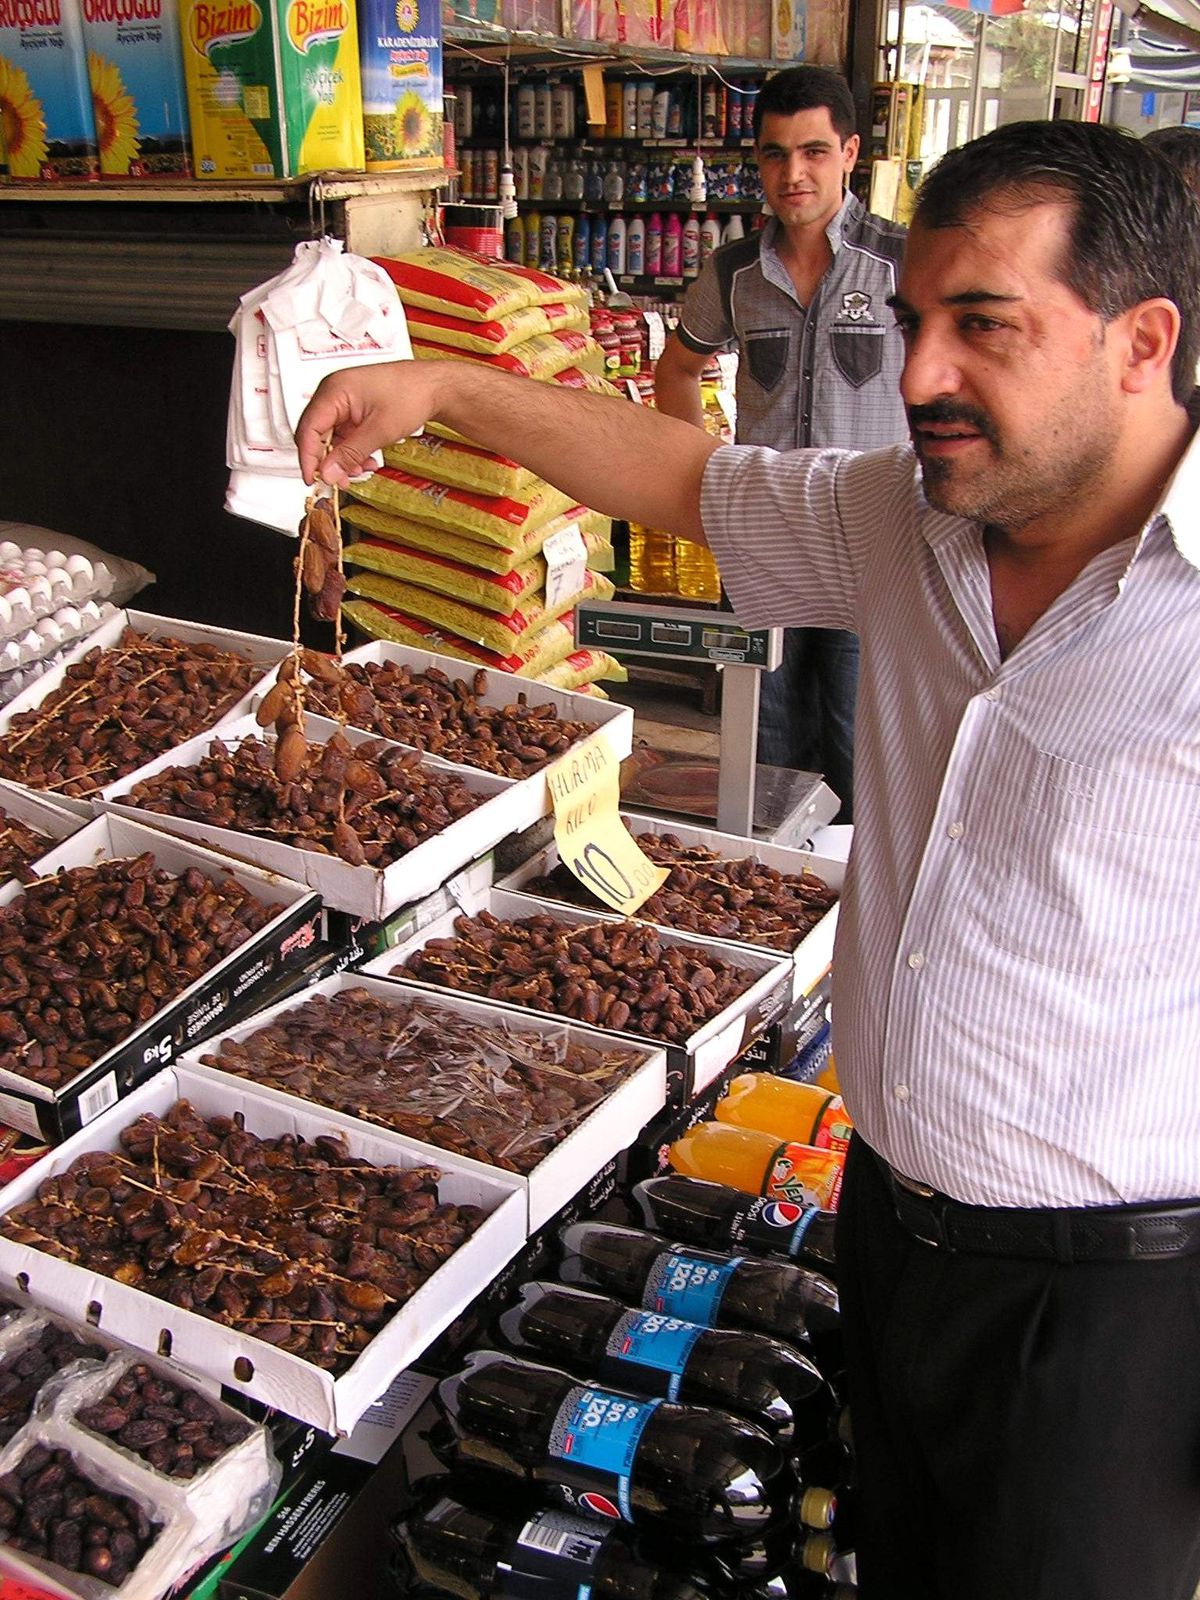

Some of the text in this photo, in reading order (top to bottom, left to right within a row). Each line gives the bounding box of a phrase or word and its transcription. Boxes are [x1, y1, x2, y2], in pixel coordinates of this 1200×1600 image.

[194, 4, 253, 39] Bizim
[293, 1, 345, 35] Bizim
[550, 746, 607, 802] HURMA
[668, 1262, 695, 1292] 120
[690, 1266, 709, 1286] 90
[583, 1397, 611, 1428] 120
[606, 1401, 627, 1423] 90
[264, 1535, 282, 1554] BEN
[277, 1504, 306, 1537] HASSEN
